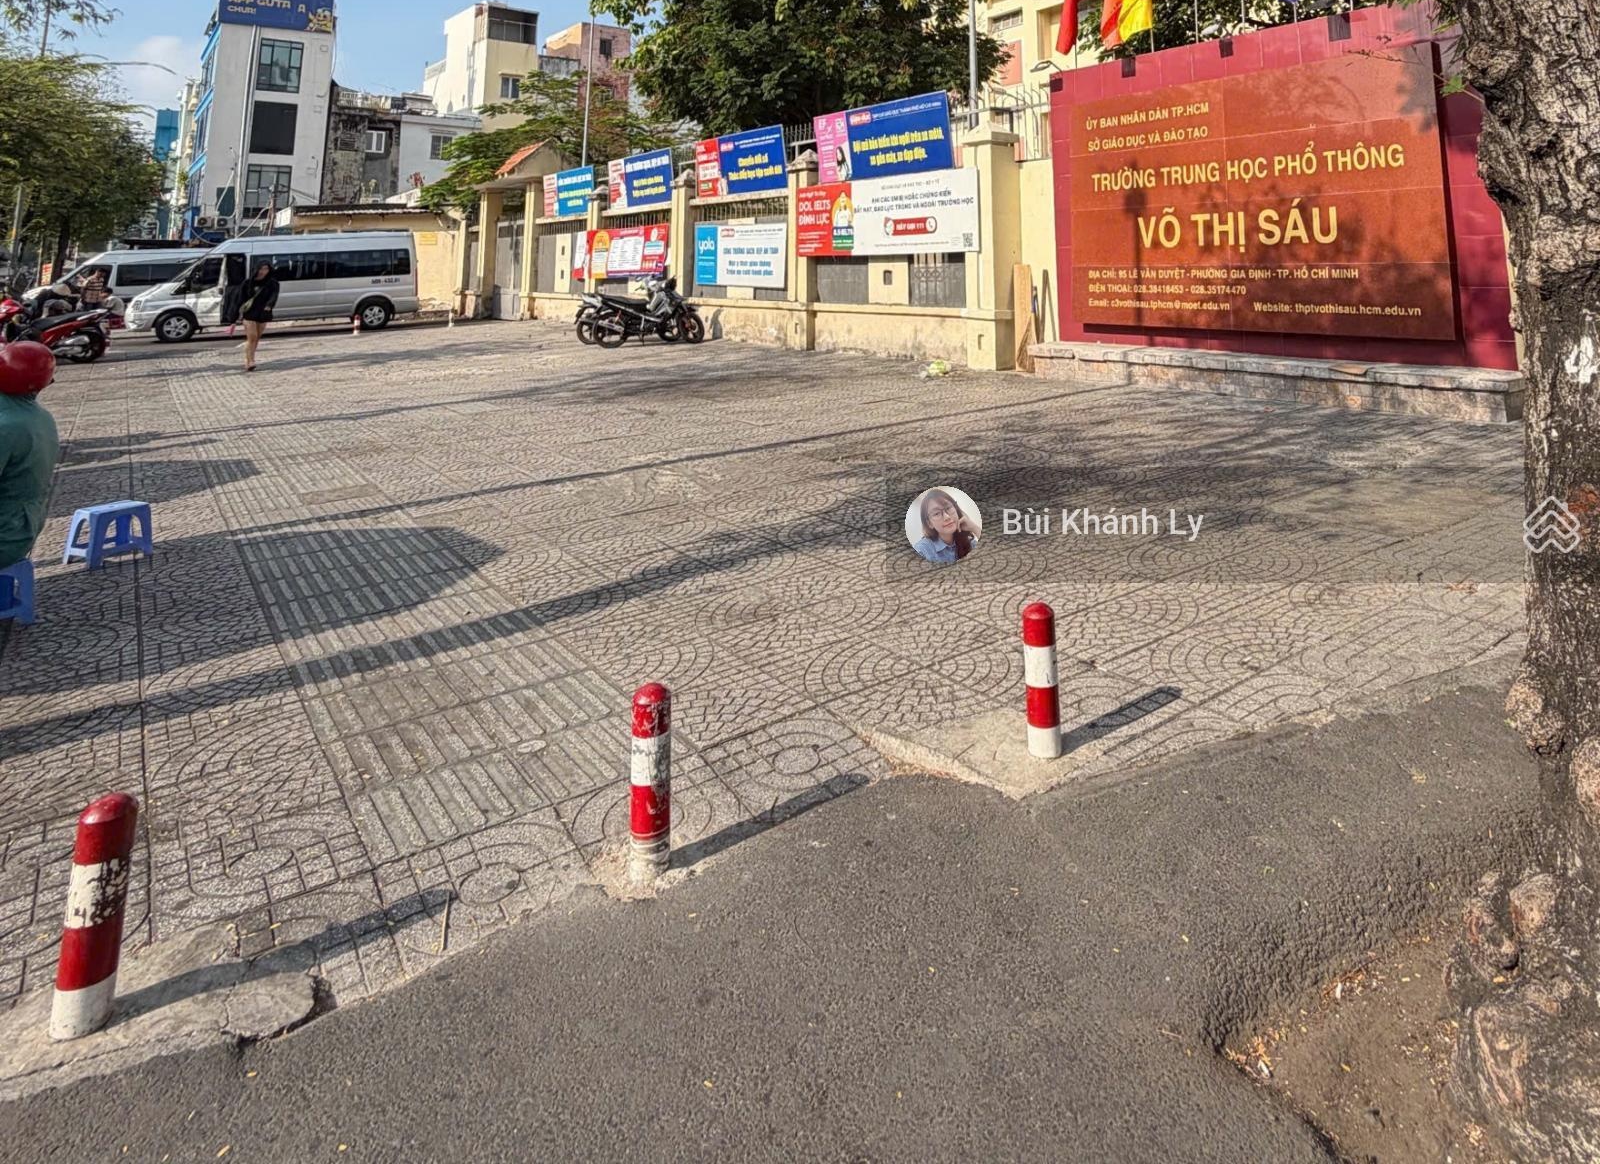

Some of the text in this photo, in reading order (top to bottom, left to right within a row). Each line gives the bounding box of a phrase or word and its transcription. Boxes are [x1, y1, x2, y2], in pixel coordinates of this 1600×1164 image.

[1100, 116, 1118, 128] BAN
[1120, 111, 1146, 125] NHÂN
[1148, 107, 1169, 121] DÂN
[1171, 102, 1209, 118] TP.HCM
[1088, 126, 1208, 151] SỞ GIÁO DỤC VÀ ĐÀO TẠO
[1092, 141, 1405, 192] TRƯỜNG TRUNG HỌC PHỔ THÔNG
[1138, 198, 1338, 253] VÕ THỊ SÁU
[698, 236, 715, 254] yola
[1128, 268, 1138, 279] LÊ
[1140, 268, 1156, 279] VĂN
[1158, 268, 1185, 279] DUYỆT
[1190, 268, 1228, 279] PHƯỜNG
[1231, 270, 1246, 279] GIA
[1294, 266, 1308, 279] HỒ
[1311, 266, 1329, 279] CHÍ
[1331, 268, 1359, 279] MINH
[1088, 298, 1110, 307] Email:
[1254, 302, 1421, 316] Website: thptvothisau.hcm.edu.vn
